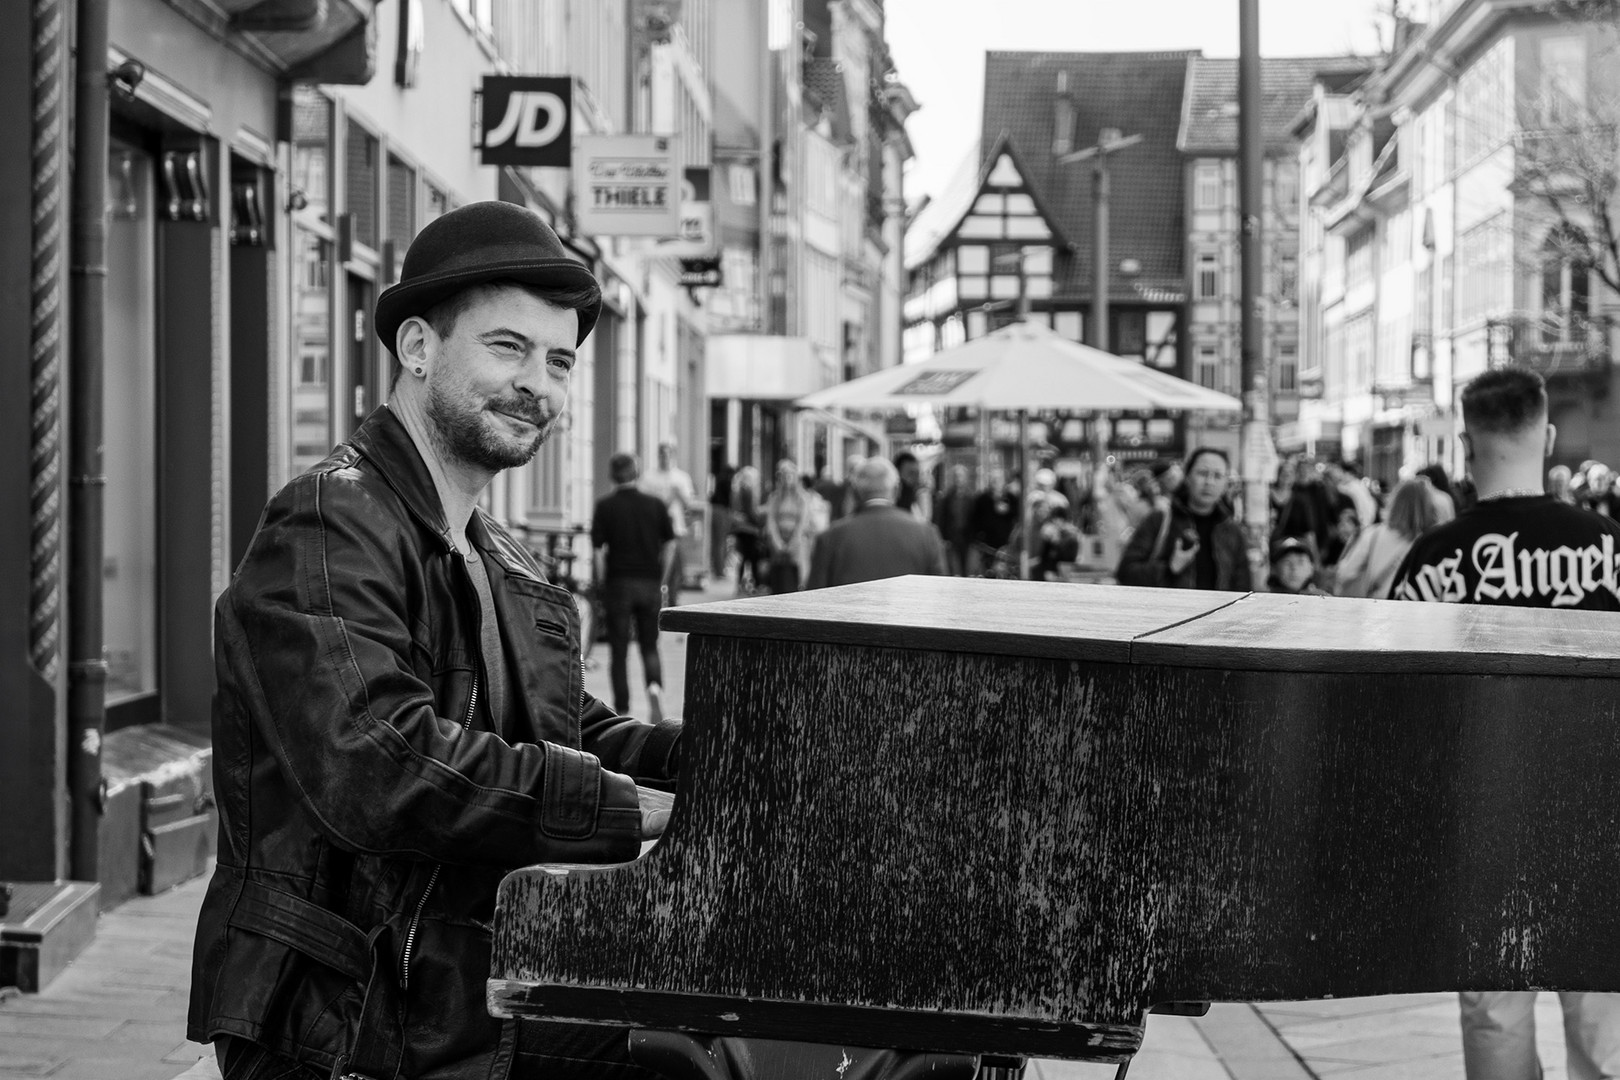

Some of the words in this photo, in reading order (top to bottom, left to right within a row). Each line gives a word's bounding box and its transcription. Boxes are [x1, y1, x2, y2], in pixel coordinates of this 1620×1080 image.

[487, 92, 566, 147] JD
[592, 186, 668, 206] THIELE
[1472, 531, 1620, 606] Angel
